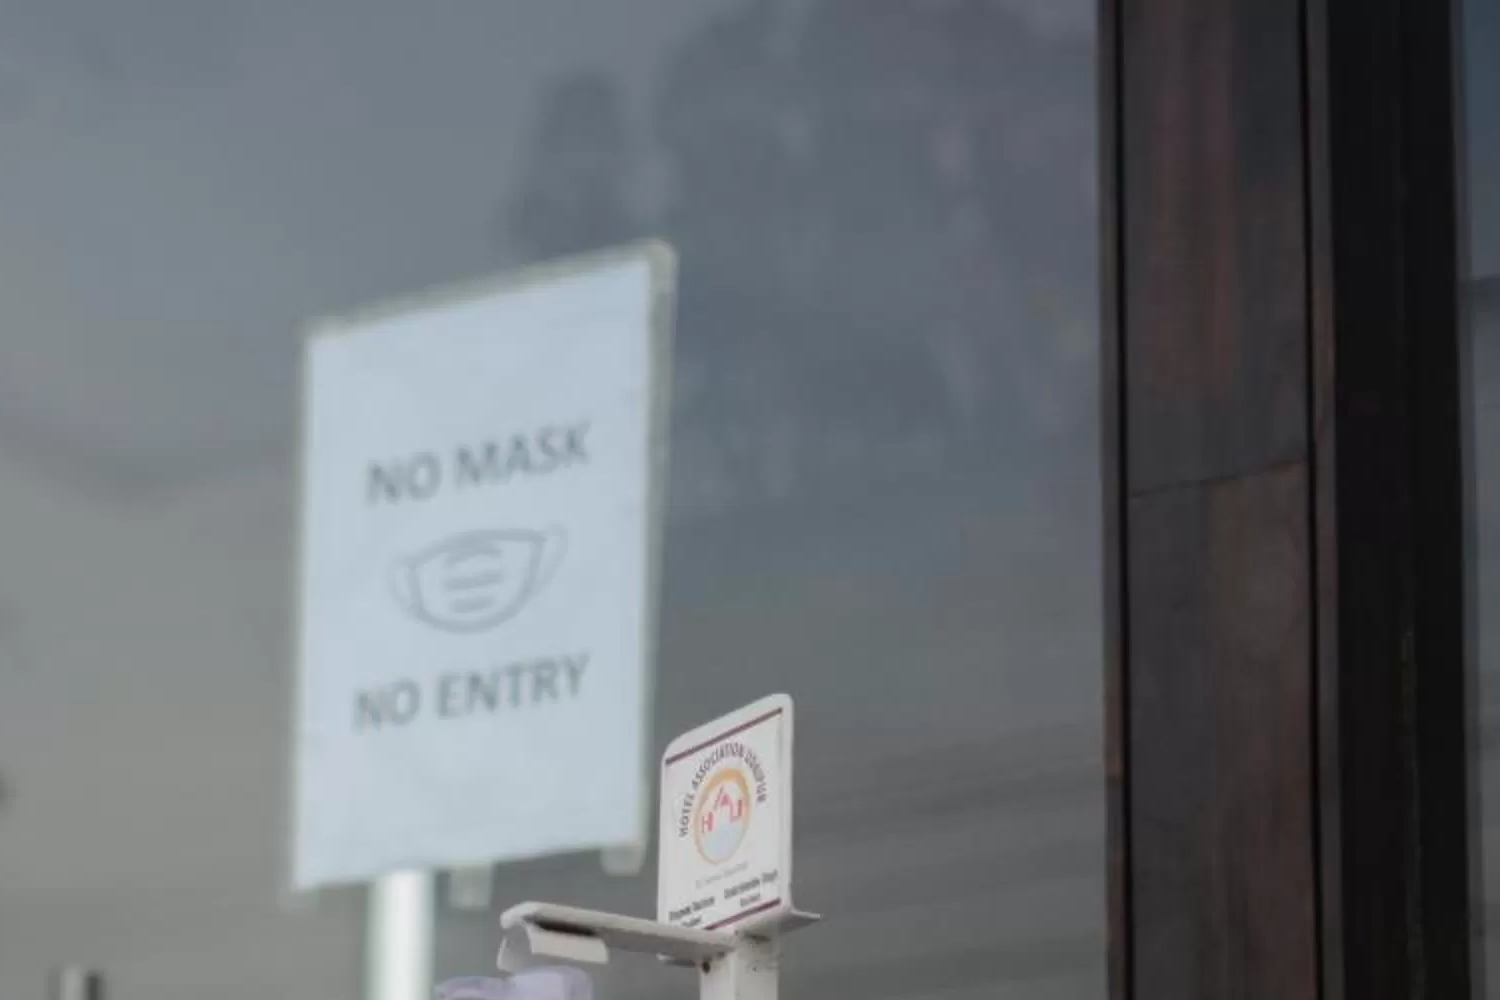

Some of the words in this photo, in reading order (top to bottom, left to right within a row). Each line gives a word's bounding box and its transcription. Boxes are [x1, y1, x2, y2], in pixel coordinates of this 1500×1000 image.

[365, 452, 442, 505] NO
[455, 420, 591, 490] MASK
[352, 678, 422, 735] NO
[435, 652, 590, 720] ENTRY
[678, 793, 695, 838] HOTEL
[691, 742, 744, 793] ASSOCIATION
